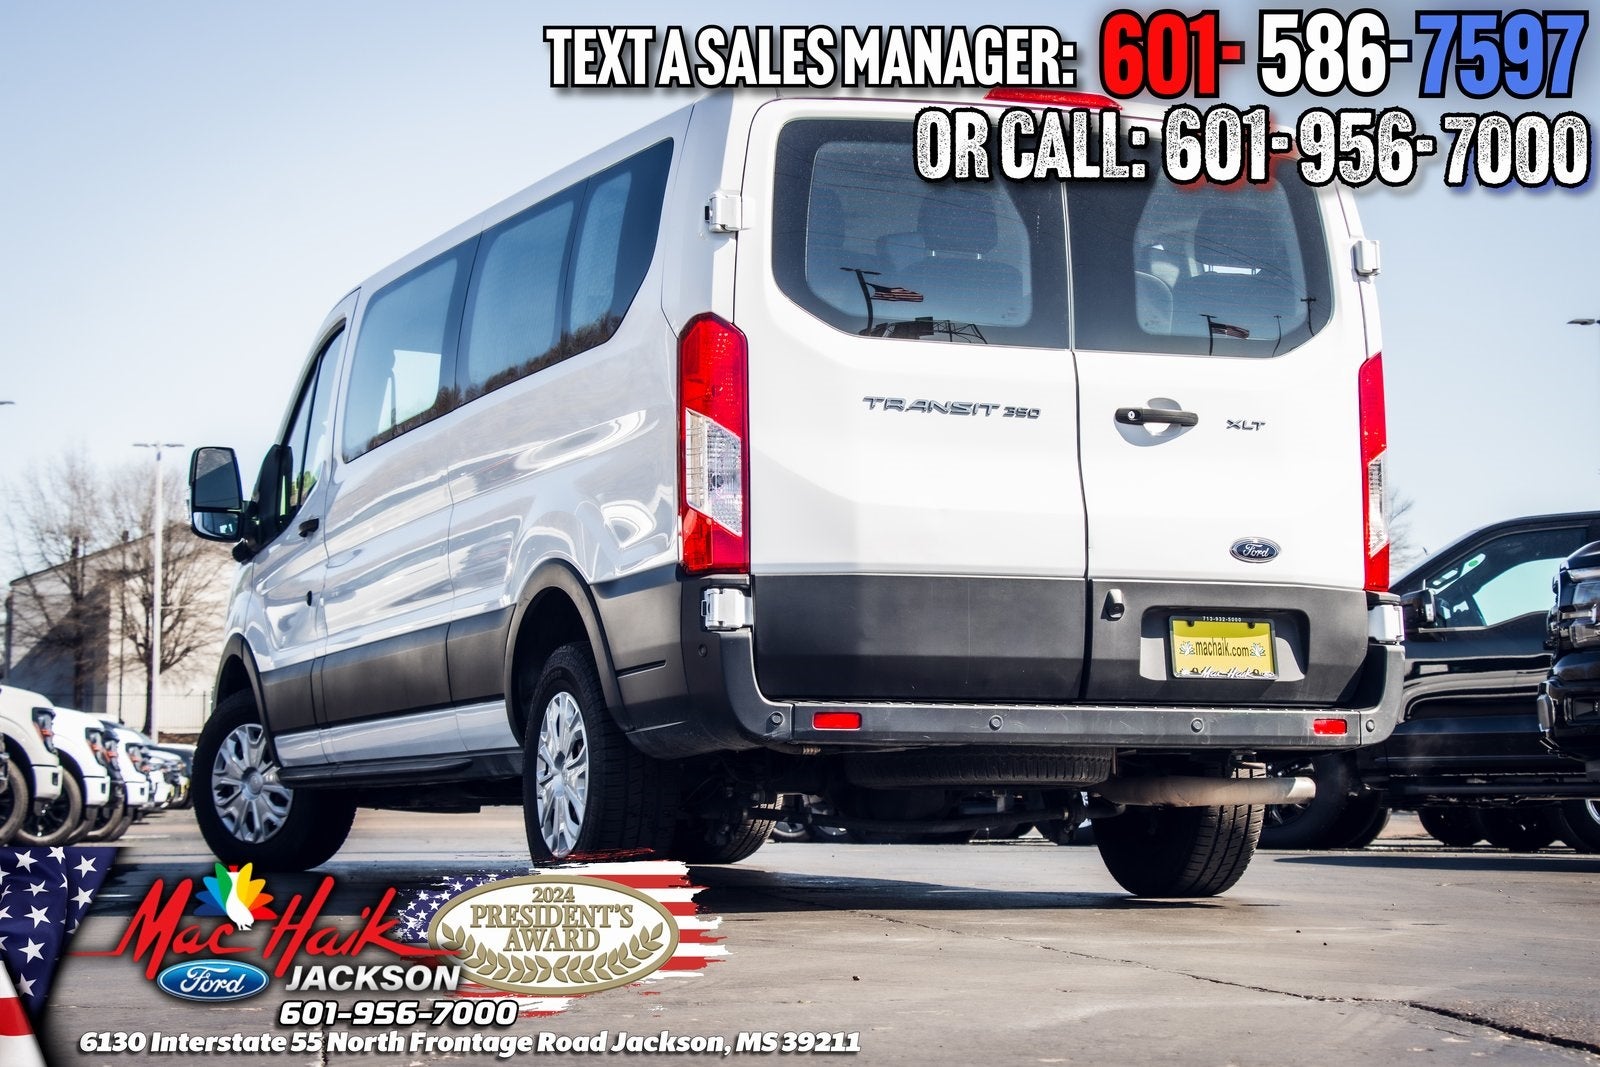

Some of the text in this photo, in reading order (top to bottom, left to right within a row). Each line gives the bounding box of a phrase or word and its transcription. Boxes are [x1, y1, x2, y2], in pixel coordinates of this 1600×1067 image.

[863, 396, 1041, 420] TRANSIT 350
[1226, 418, 1266, 432] XLT
[1243, 543, 1269, 557] Ford
[1195, 637, 1250, 657] machaik.com
